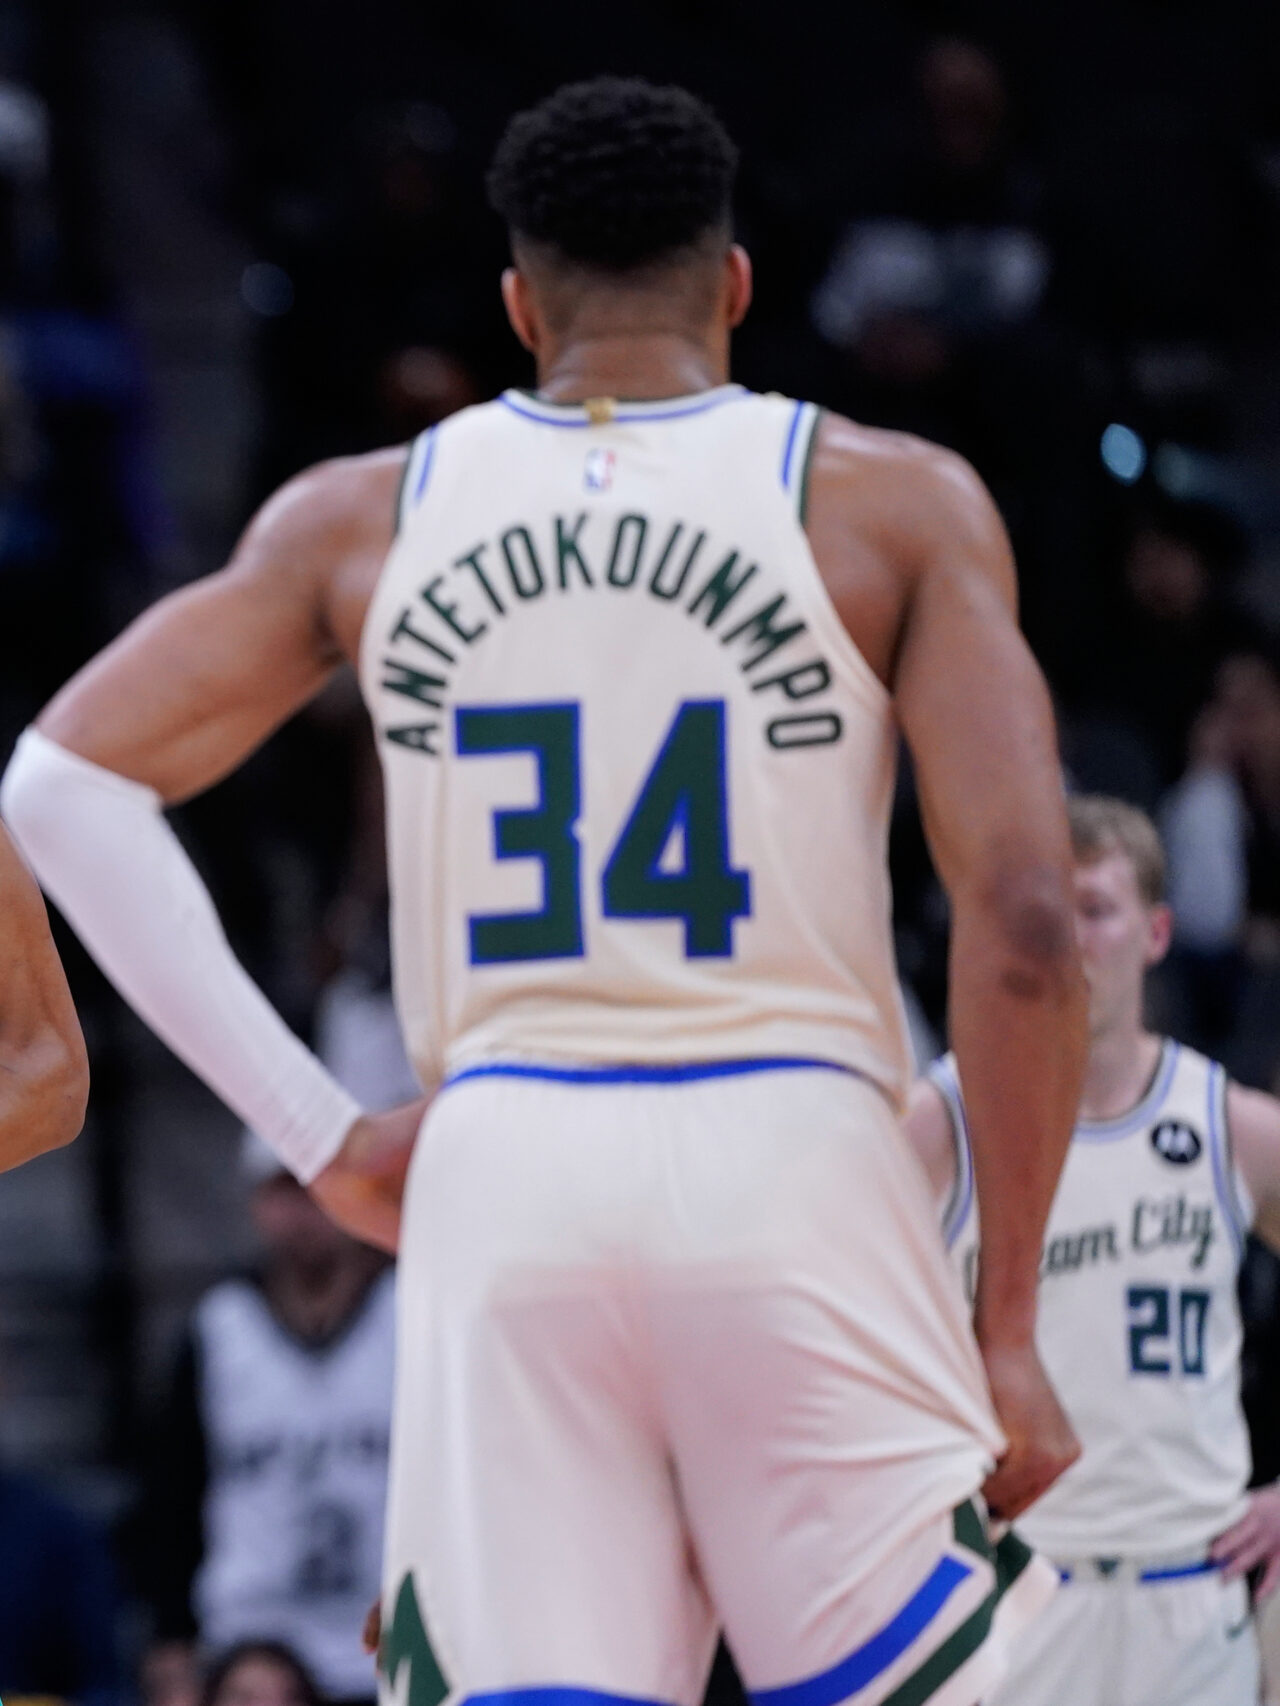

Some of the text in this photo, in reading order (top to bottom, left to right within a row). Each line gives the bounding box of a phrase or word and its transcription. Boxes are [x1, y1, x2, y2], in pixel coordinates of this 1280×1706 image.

[381, 512, 843, 756] ANTETOKOUNMPO
[454, 698, 754, 967] 34
[1131, 1197, 1216, 1270] City
[1126, 1286, 1212, 1376] 20
